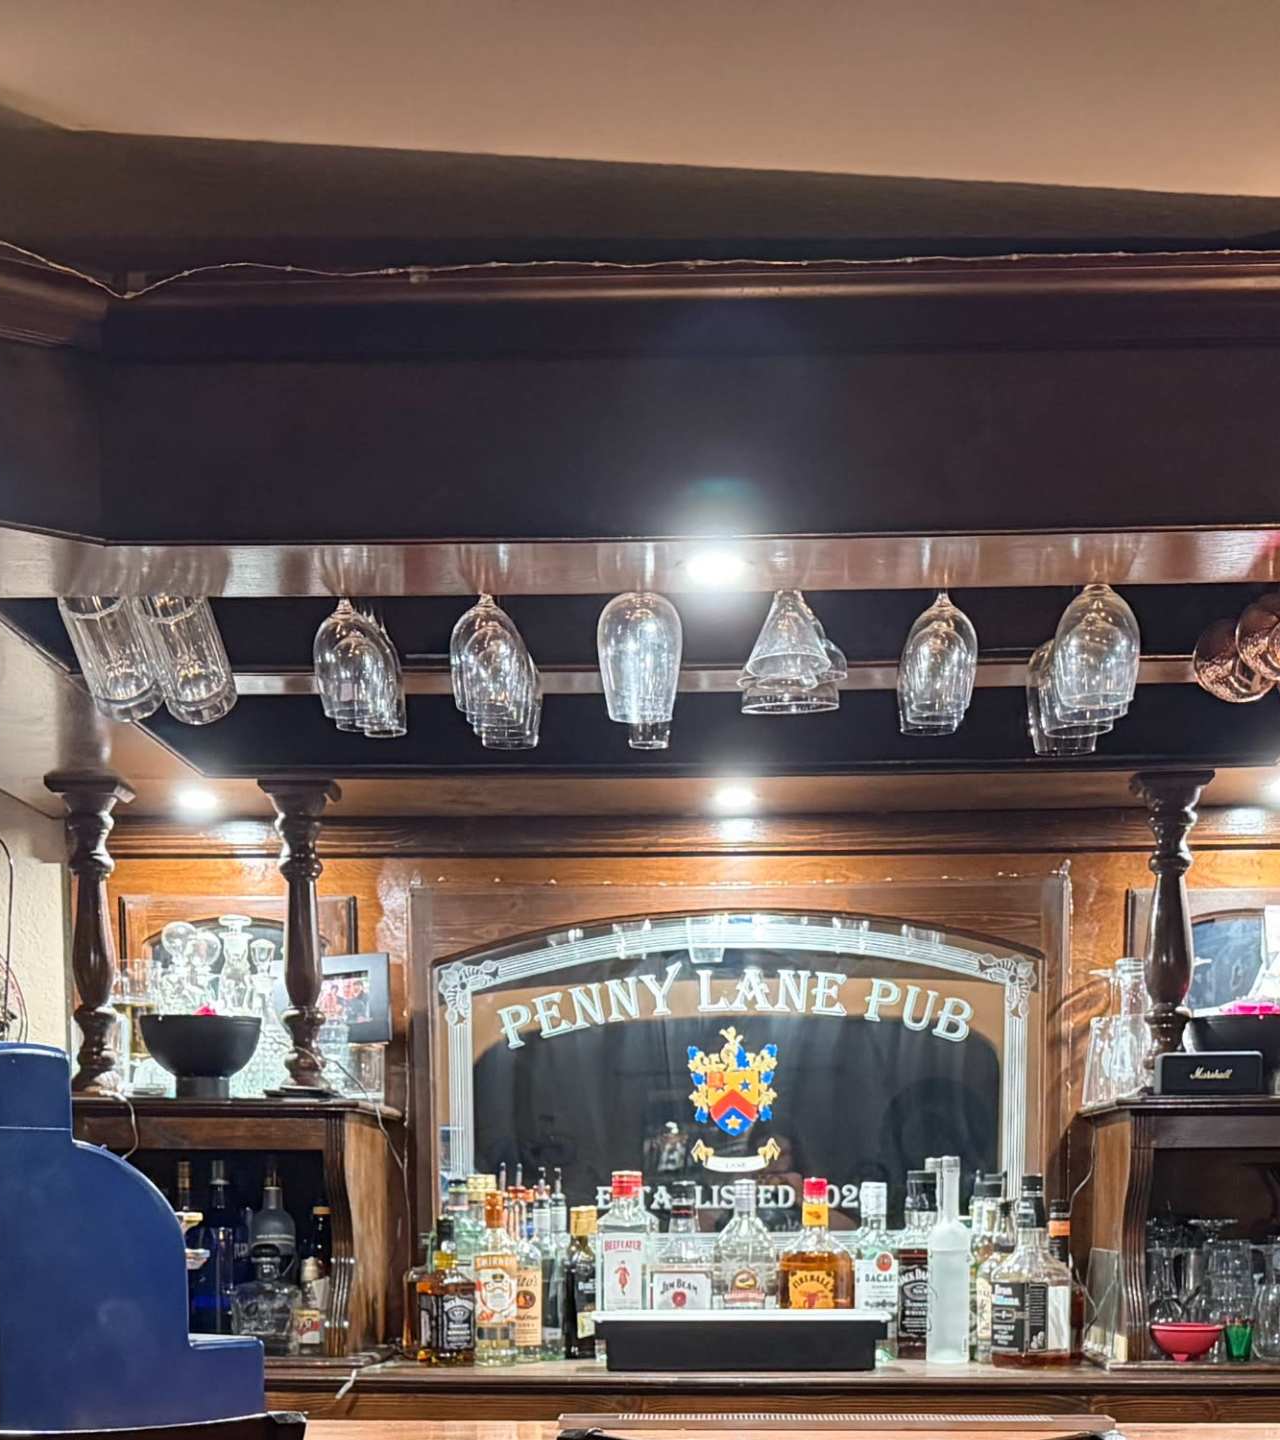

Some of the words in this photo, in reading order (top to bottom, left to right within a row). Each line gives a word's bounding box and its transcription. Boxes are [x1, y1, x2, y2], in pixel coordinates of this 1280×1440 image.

[497, 961, 683, 1050] PENNY
[695, 966, 848, 1017] LANE
[863, 977, 974, 1043] PUB
[1189, 1066, 1233, 1080] Marshall
[595, 1184, 796, 1210] ETALISED
